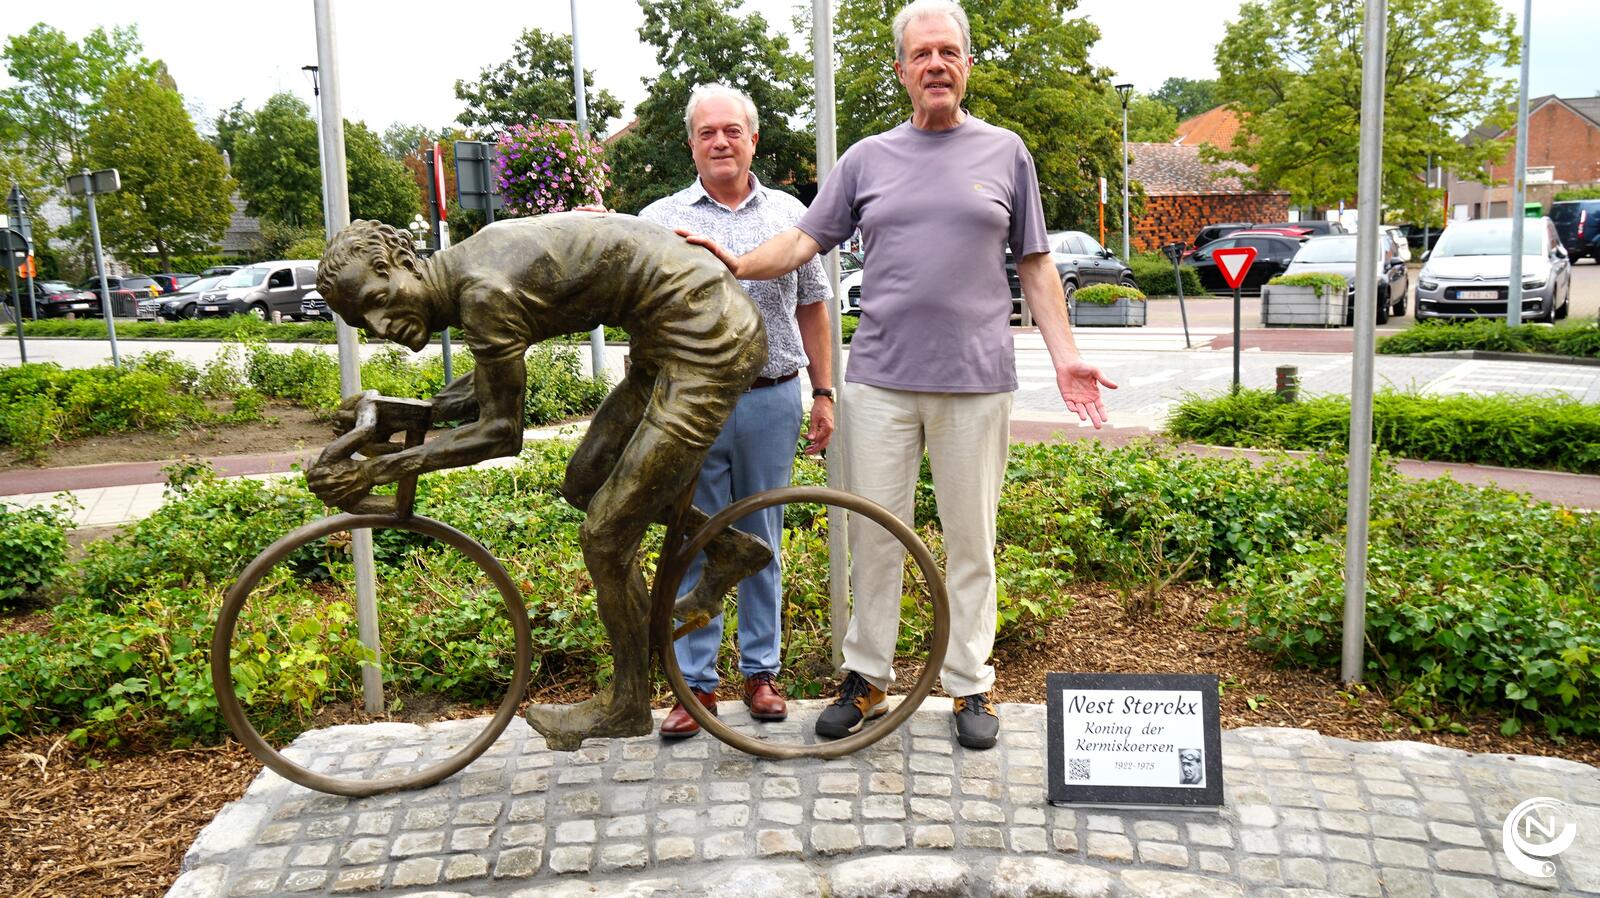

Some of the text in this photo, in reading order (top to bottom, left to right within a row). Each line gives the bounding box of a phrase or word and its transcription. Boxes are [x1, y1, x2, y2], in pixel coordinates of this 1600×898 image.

[1069, 694, 1198, 715] Nest Sterckx
[1085, 721, 1165, 737] Koning der
[1075, 738, 1174, 753] Kermiskoersen
[1115, 760, 1155, 770] 1922-1975
